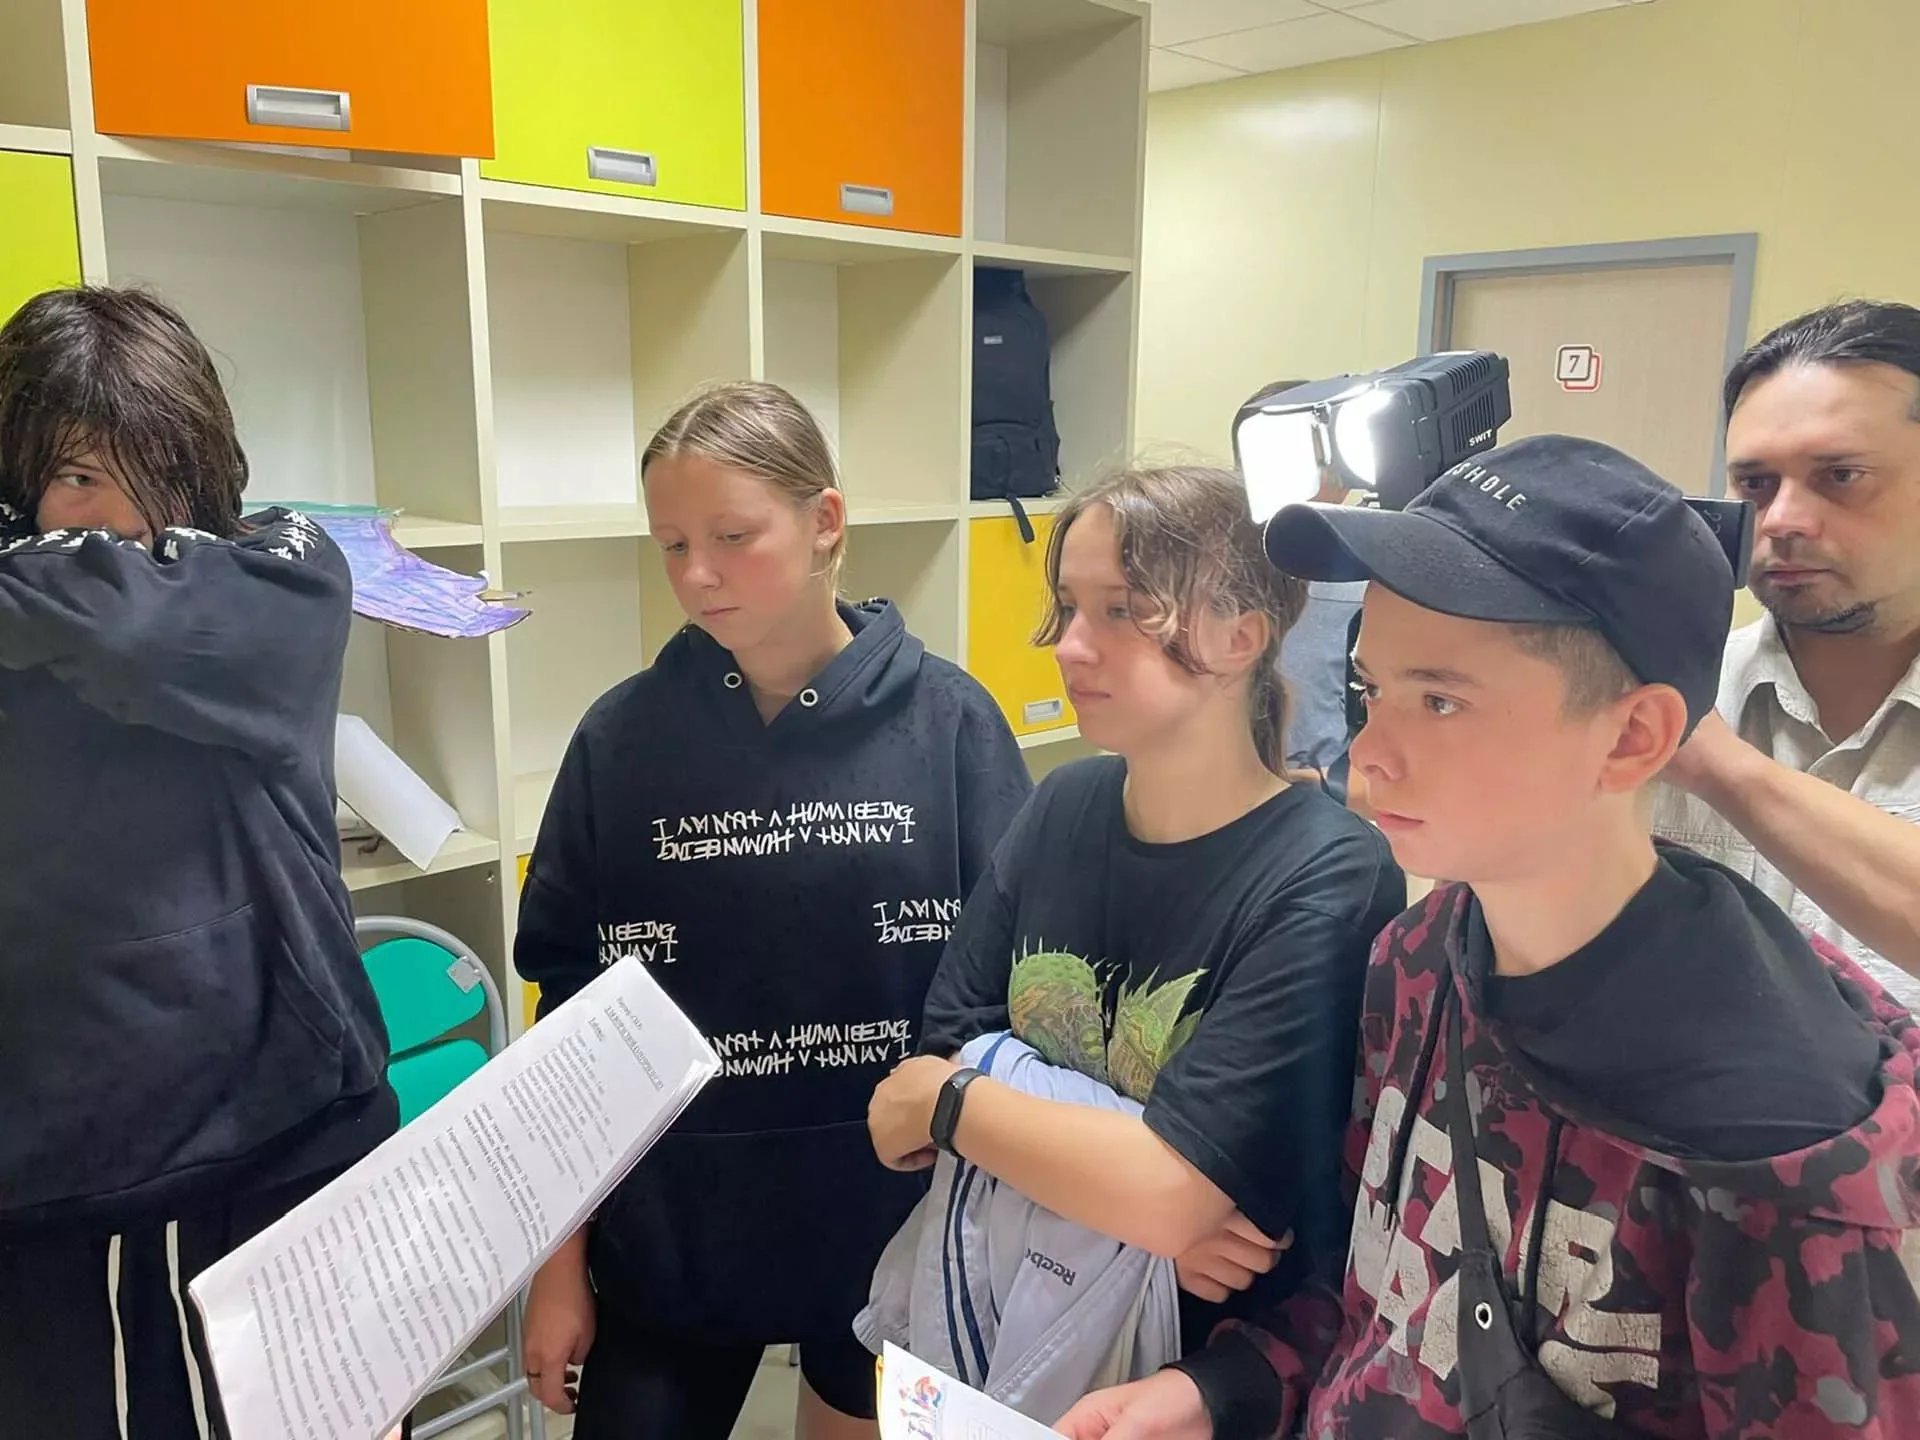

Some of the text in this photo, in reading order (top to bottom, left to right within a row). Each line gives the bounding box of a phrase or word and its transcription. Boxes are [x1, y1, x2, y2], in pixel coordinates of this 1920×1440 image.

[1569, 355, 1580, 374] 7
[1469, 429, 1493, 447] SWIT
[1444, 462, 1527, 511] SHOLE
[652, 818, 674, 842] I
[677, 814, 709, 836] AM
[769, 810, 783, 828] A
[854, 801, 915, 823] BEING
[769, 1030, 783, 1050] A
[851, 1019, 912, 1042] BEING
